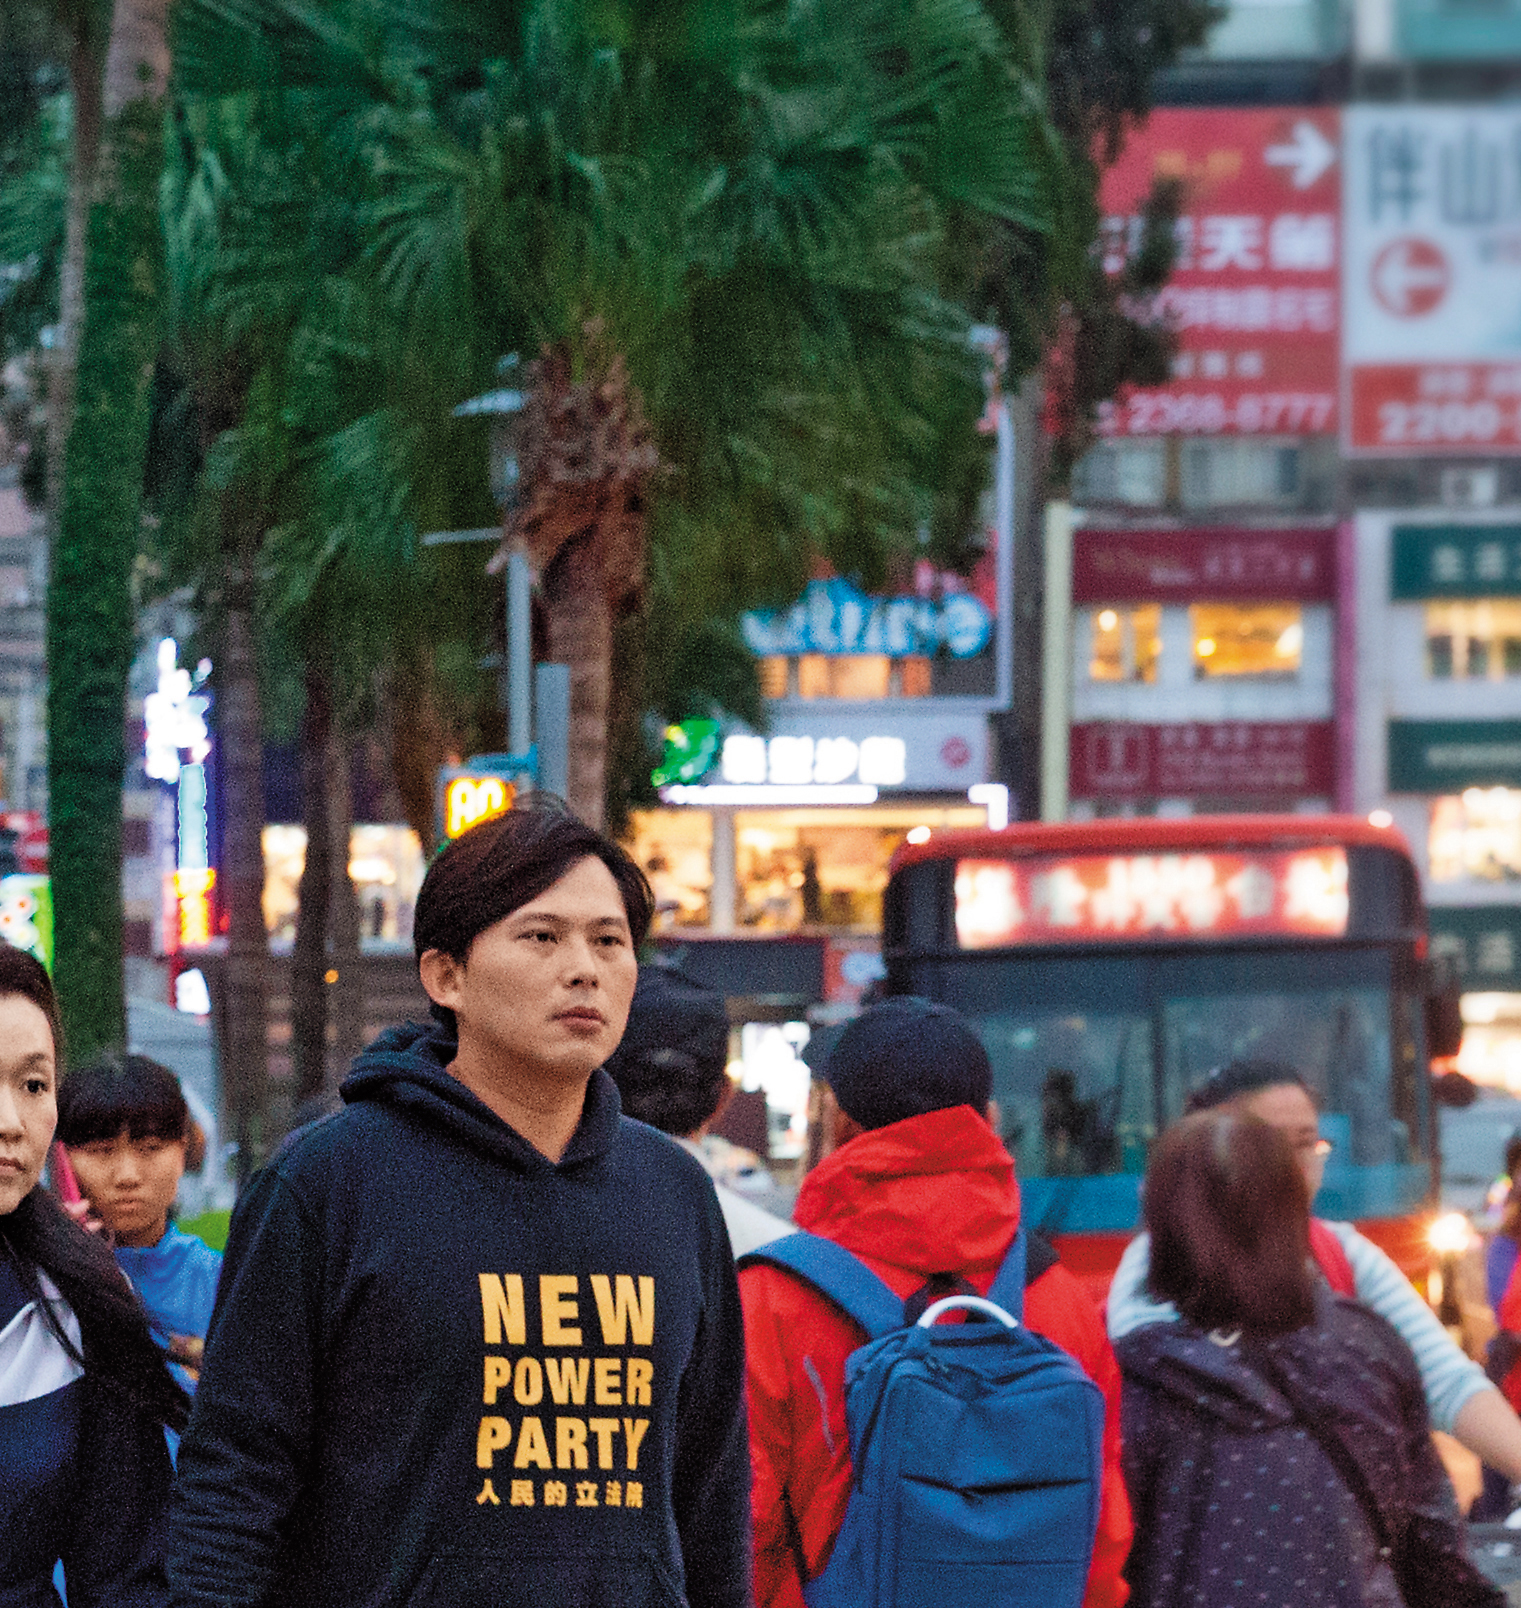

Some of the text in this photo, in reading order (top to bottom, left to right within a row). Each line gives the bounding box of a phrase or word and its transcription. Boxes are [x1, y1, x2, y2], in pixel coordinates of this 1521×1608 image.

[479, 1273, 655, 1346] NEW
[483, 1356, 654, 1406] POWER
[476, 1416, 650, 1470] PARTY
[476, 1478, 644, 1508] 人民的立法院
